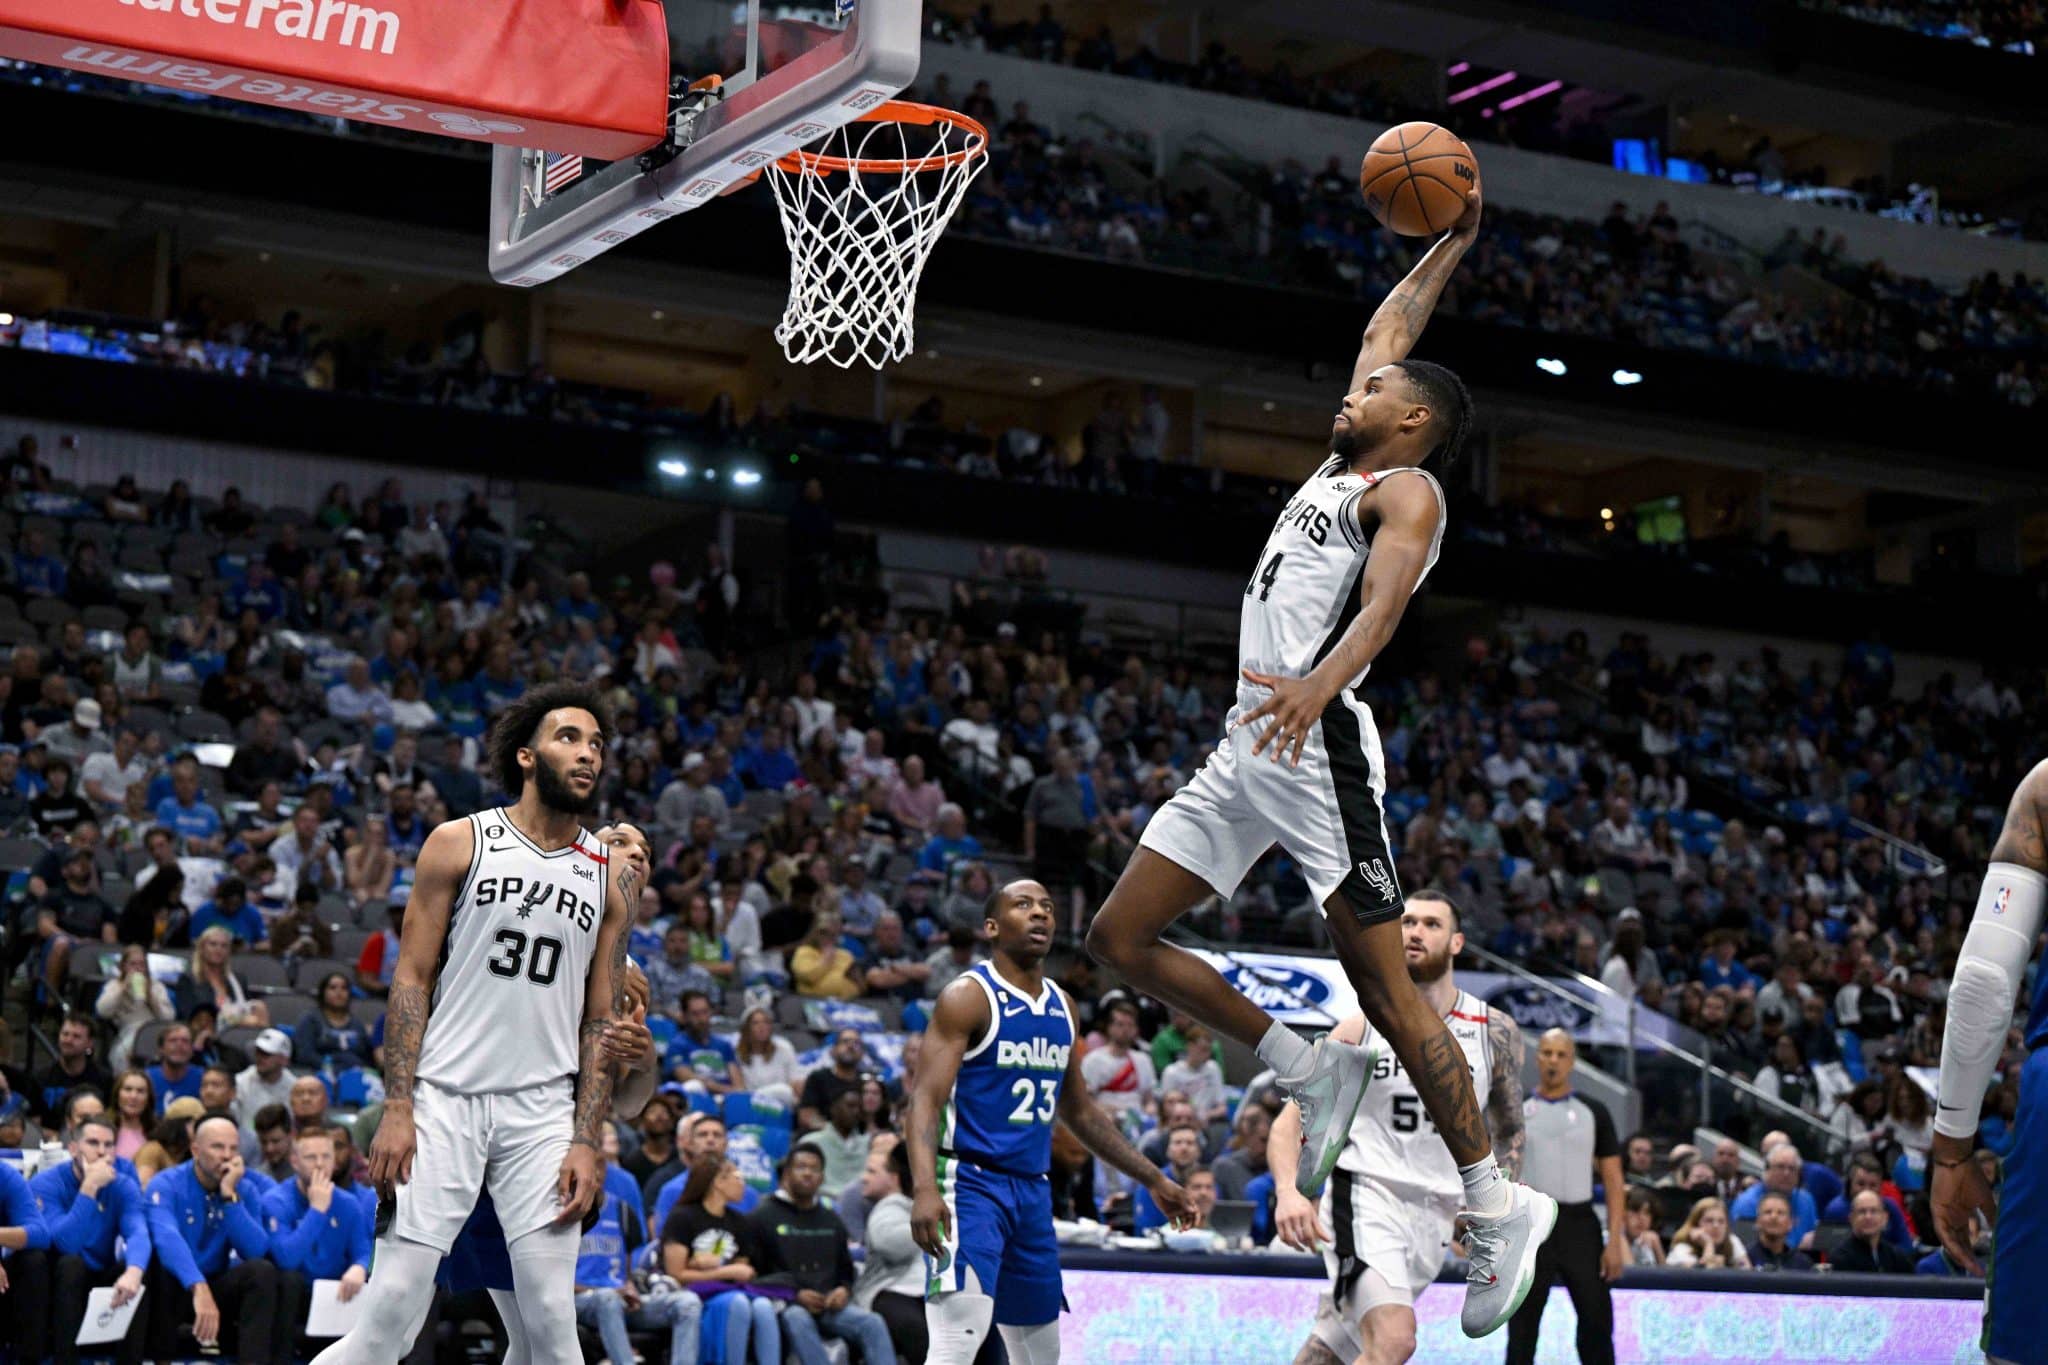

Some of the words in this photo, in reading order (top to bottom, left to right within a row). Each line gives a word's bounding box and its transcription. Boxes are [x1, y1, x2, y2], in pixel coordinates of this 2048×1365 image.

[62, 45, 422, 121] StateFarm
[490, 826, 501, 838] 6
[572, 864, 596, 883] Self.
[475, 877, 596, 934] SPURS
[486, 926, 565, 988] 30
[997, 1036, 1071, 1070] Dallas
[1008, 1077, 1058, 1124] 23
